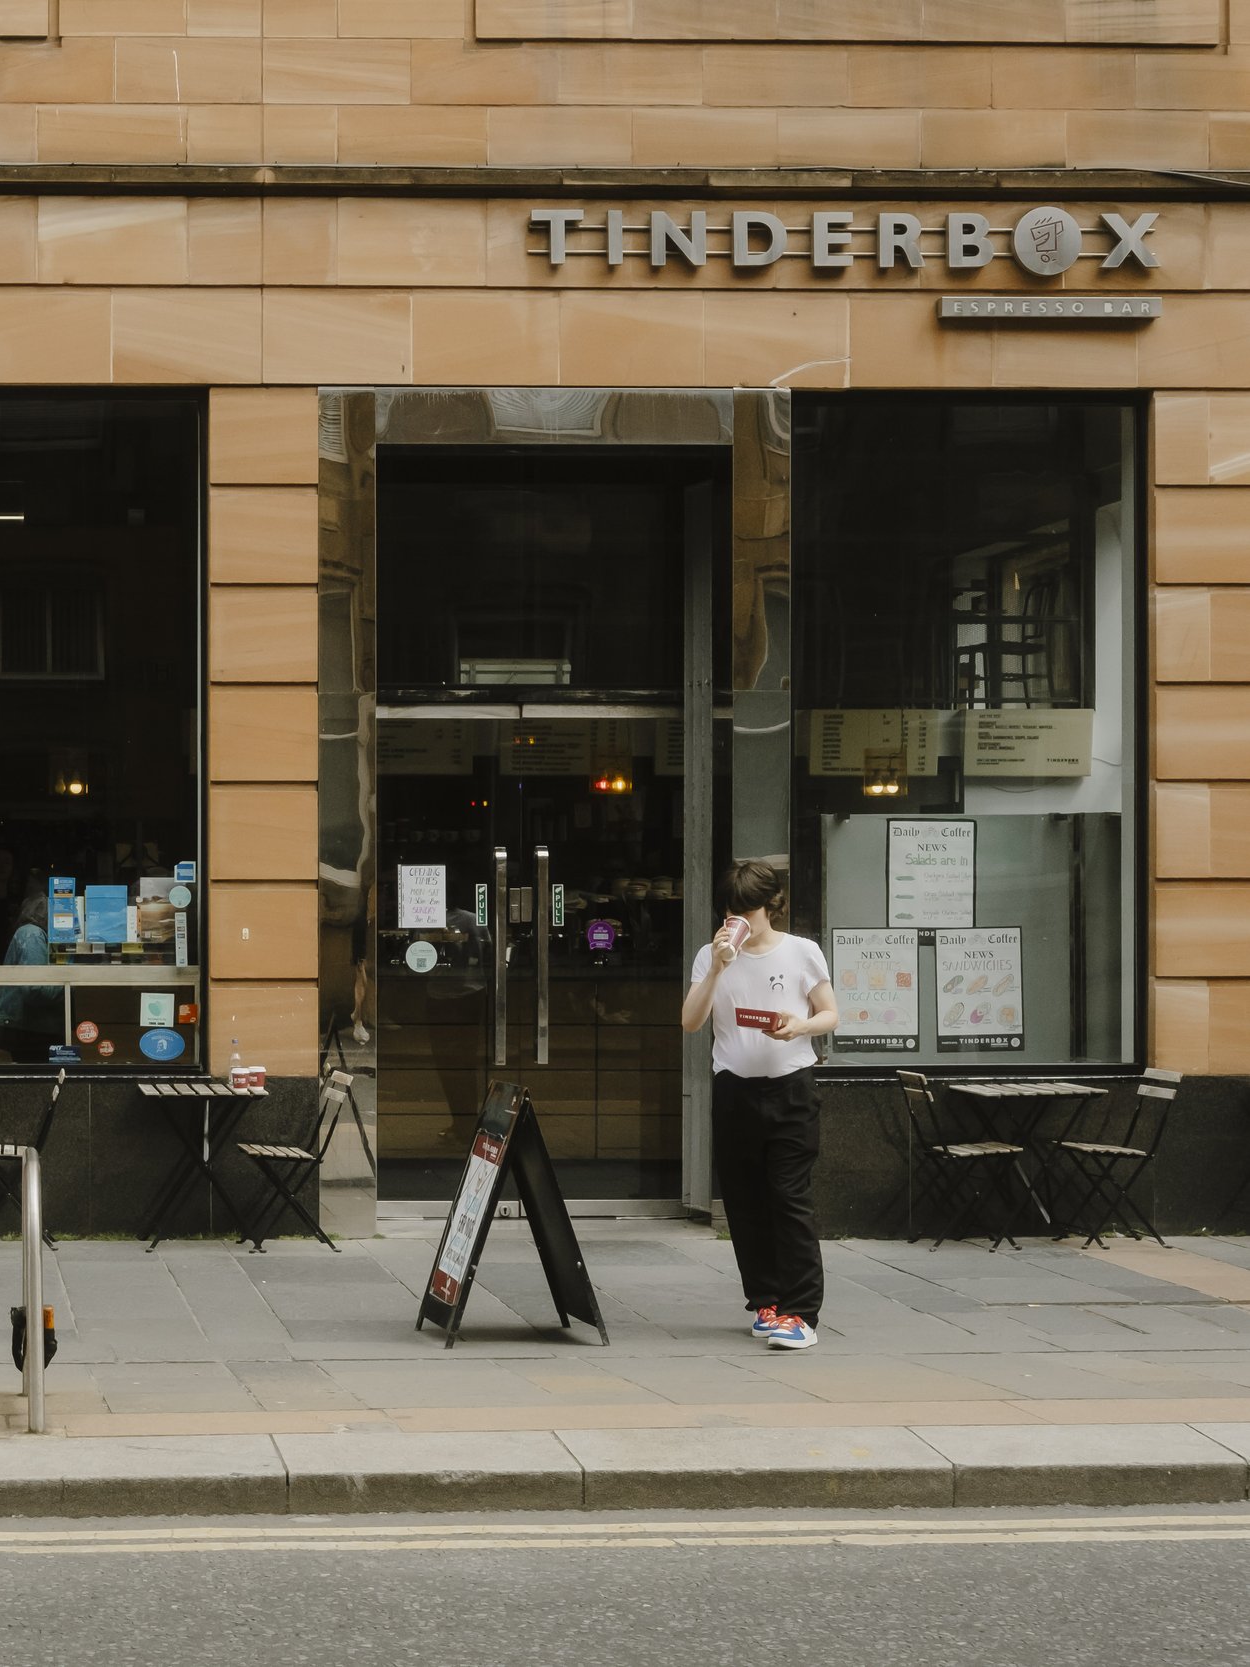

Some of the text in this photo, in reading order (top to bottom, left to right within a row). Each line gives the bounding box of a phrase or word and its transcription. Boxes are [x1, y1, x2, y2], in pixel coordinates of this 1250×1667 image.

[530, 206, 1161, 276] TINDERBOX
[953, 301, 1151, 315] ESPRESSO BAR
[893, 827, 971, 838] Daily Coffee
[917, 843, 948, 851] NEWS
[905, 853, 937, 866] Salads
[940, 857, 956, 865] are
[836, 934, 915, 946] Daily Coffee
[939, 934, 1018, 946] Daily Coffee
[861, 951, 891, 960] NEWS
[964, 950, 994, 959] NEWS
[942, 959, 1013, 971] SANDWICHES
[855, 1038, 904, 1046] TINDERBOX
[959, 1037, 1008, 1045] TINDERBOX
